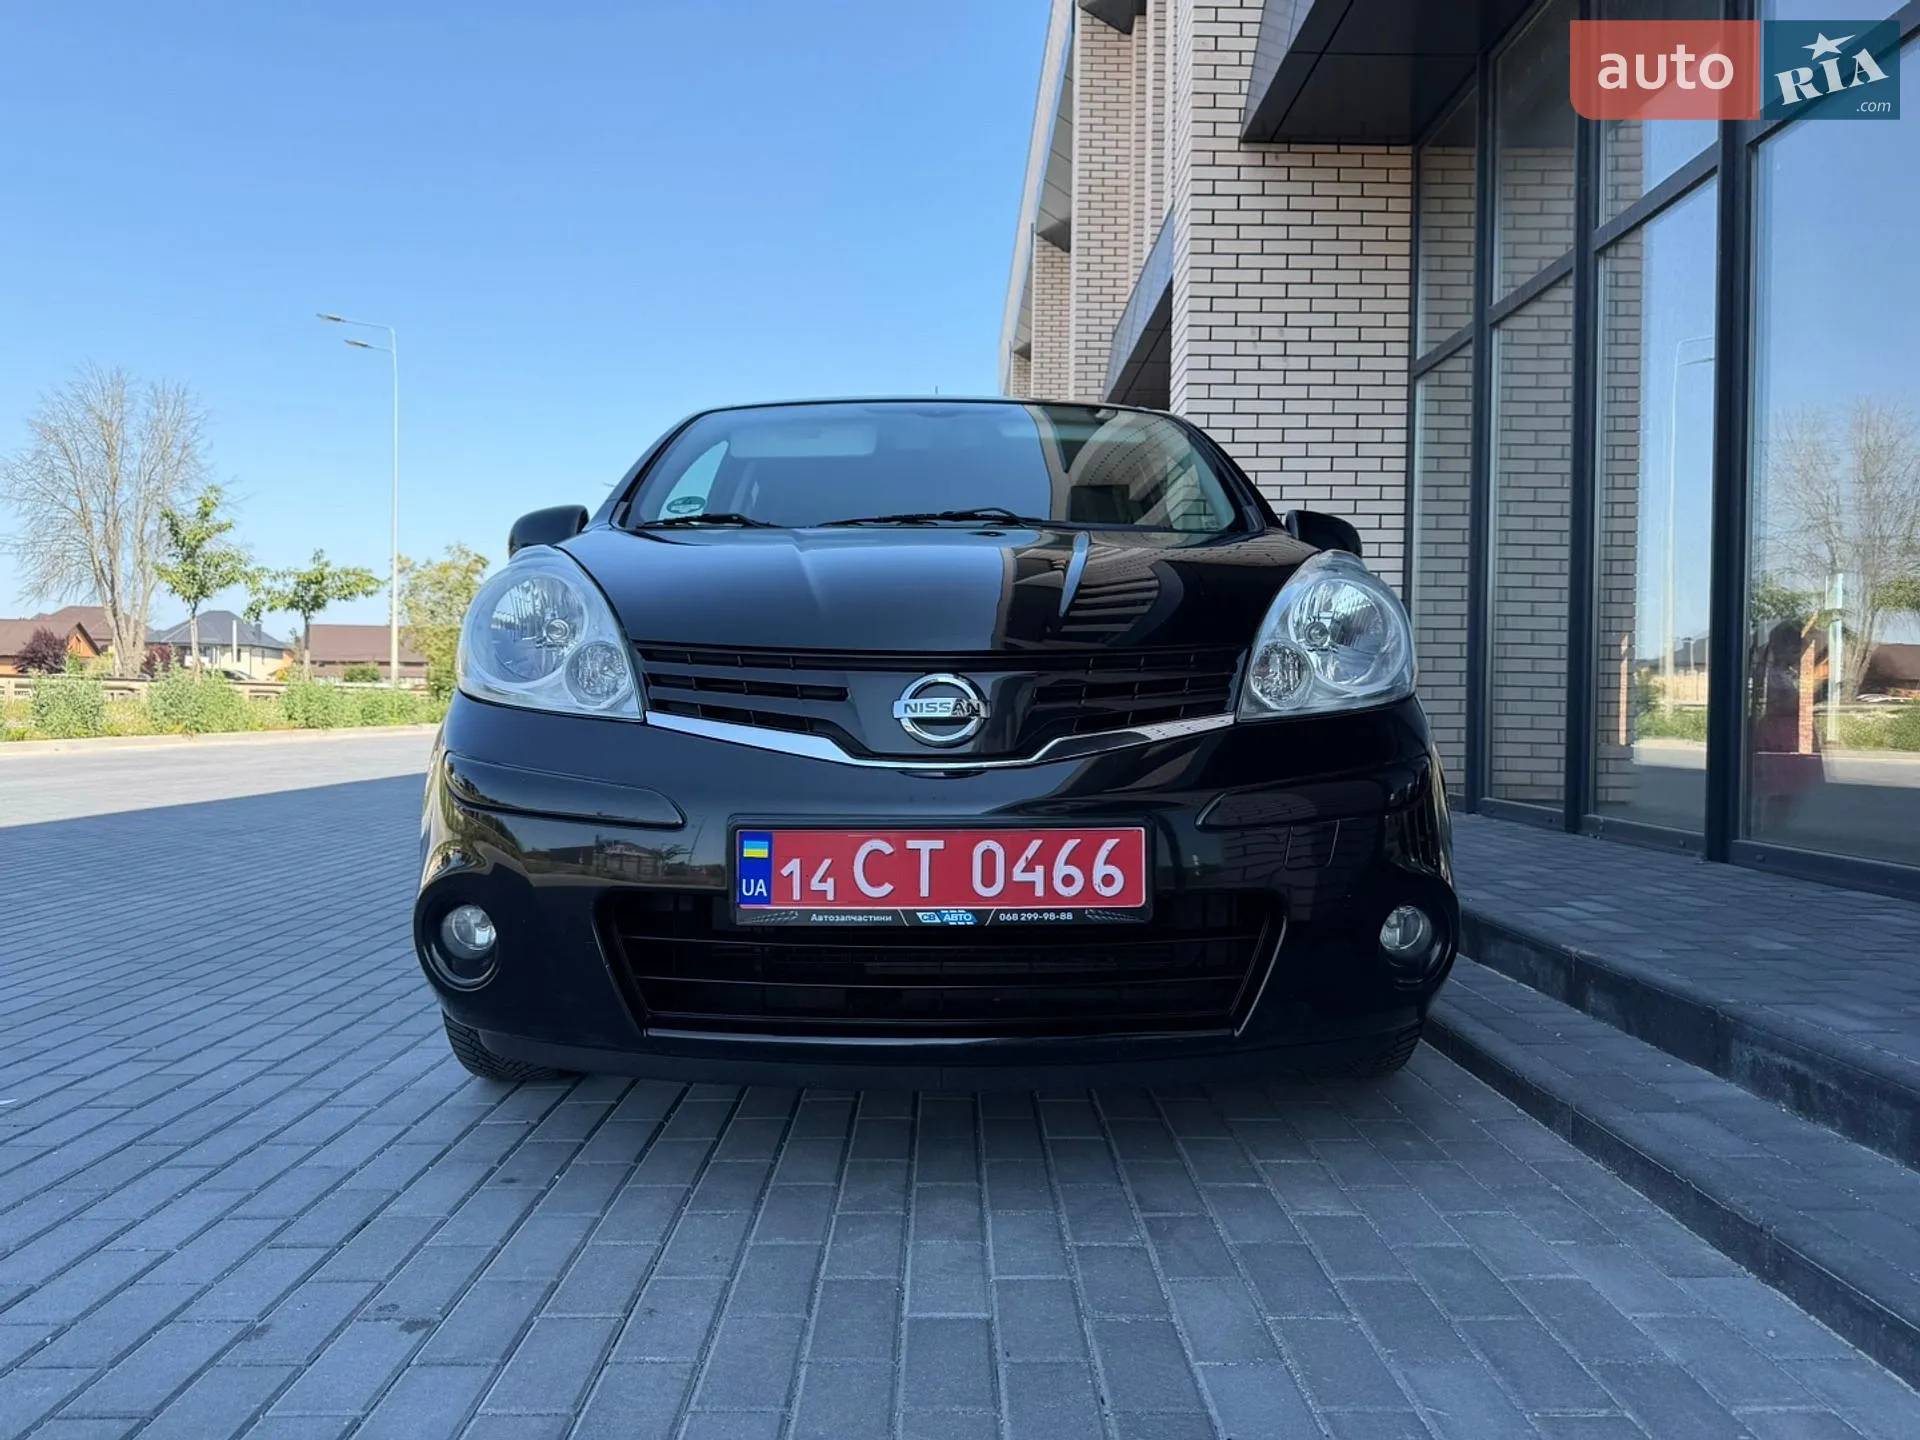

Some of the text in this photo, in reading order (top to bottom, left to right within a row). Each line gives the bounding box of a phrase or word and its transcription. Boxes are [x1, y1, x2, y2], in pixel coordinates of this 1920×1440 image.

[903, 702, 980, 716] NISSAN
[780, 858, 835, 901] 14
[972, 838, 1125, 897] 0466
[742, 878, 767, 897] UA
[810, 913, 892, 922] Автозапчастини
[999, 911, 1073, 921] 068 299-98-88
